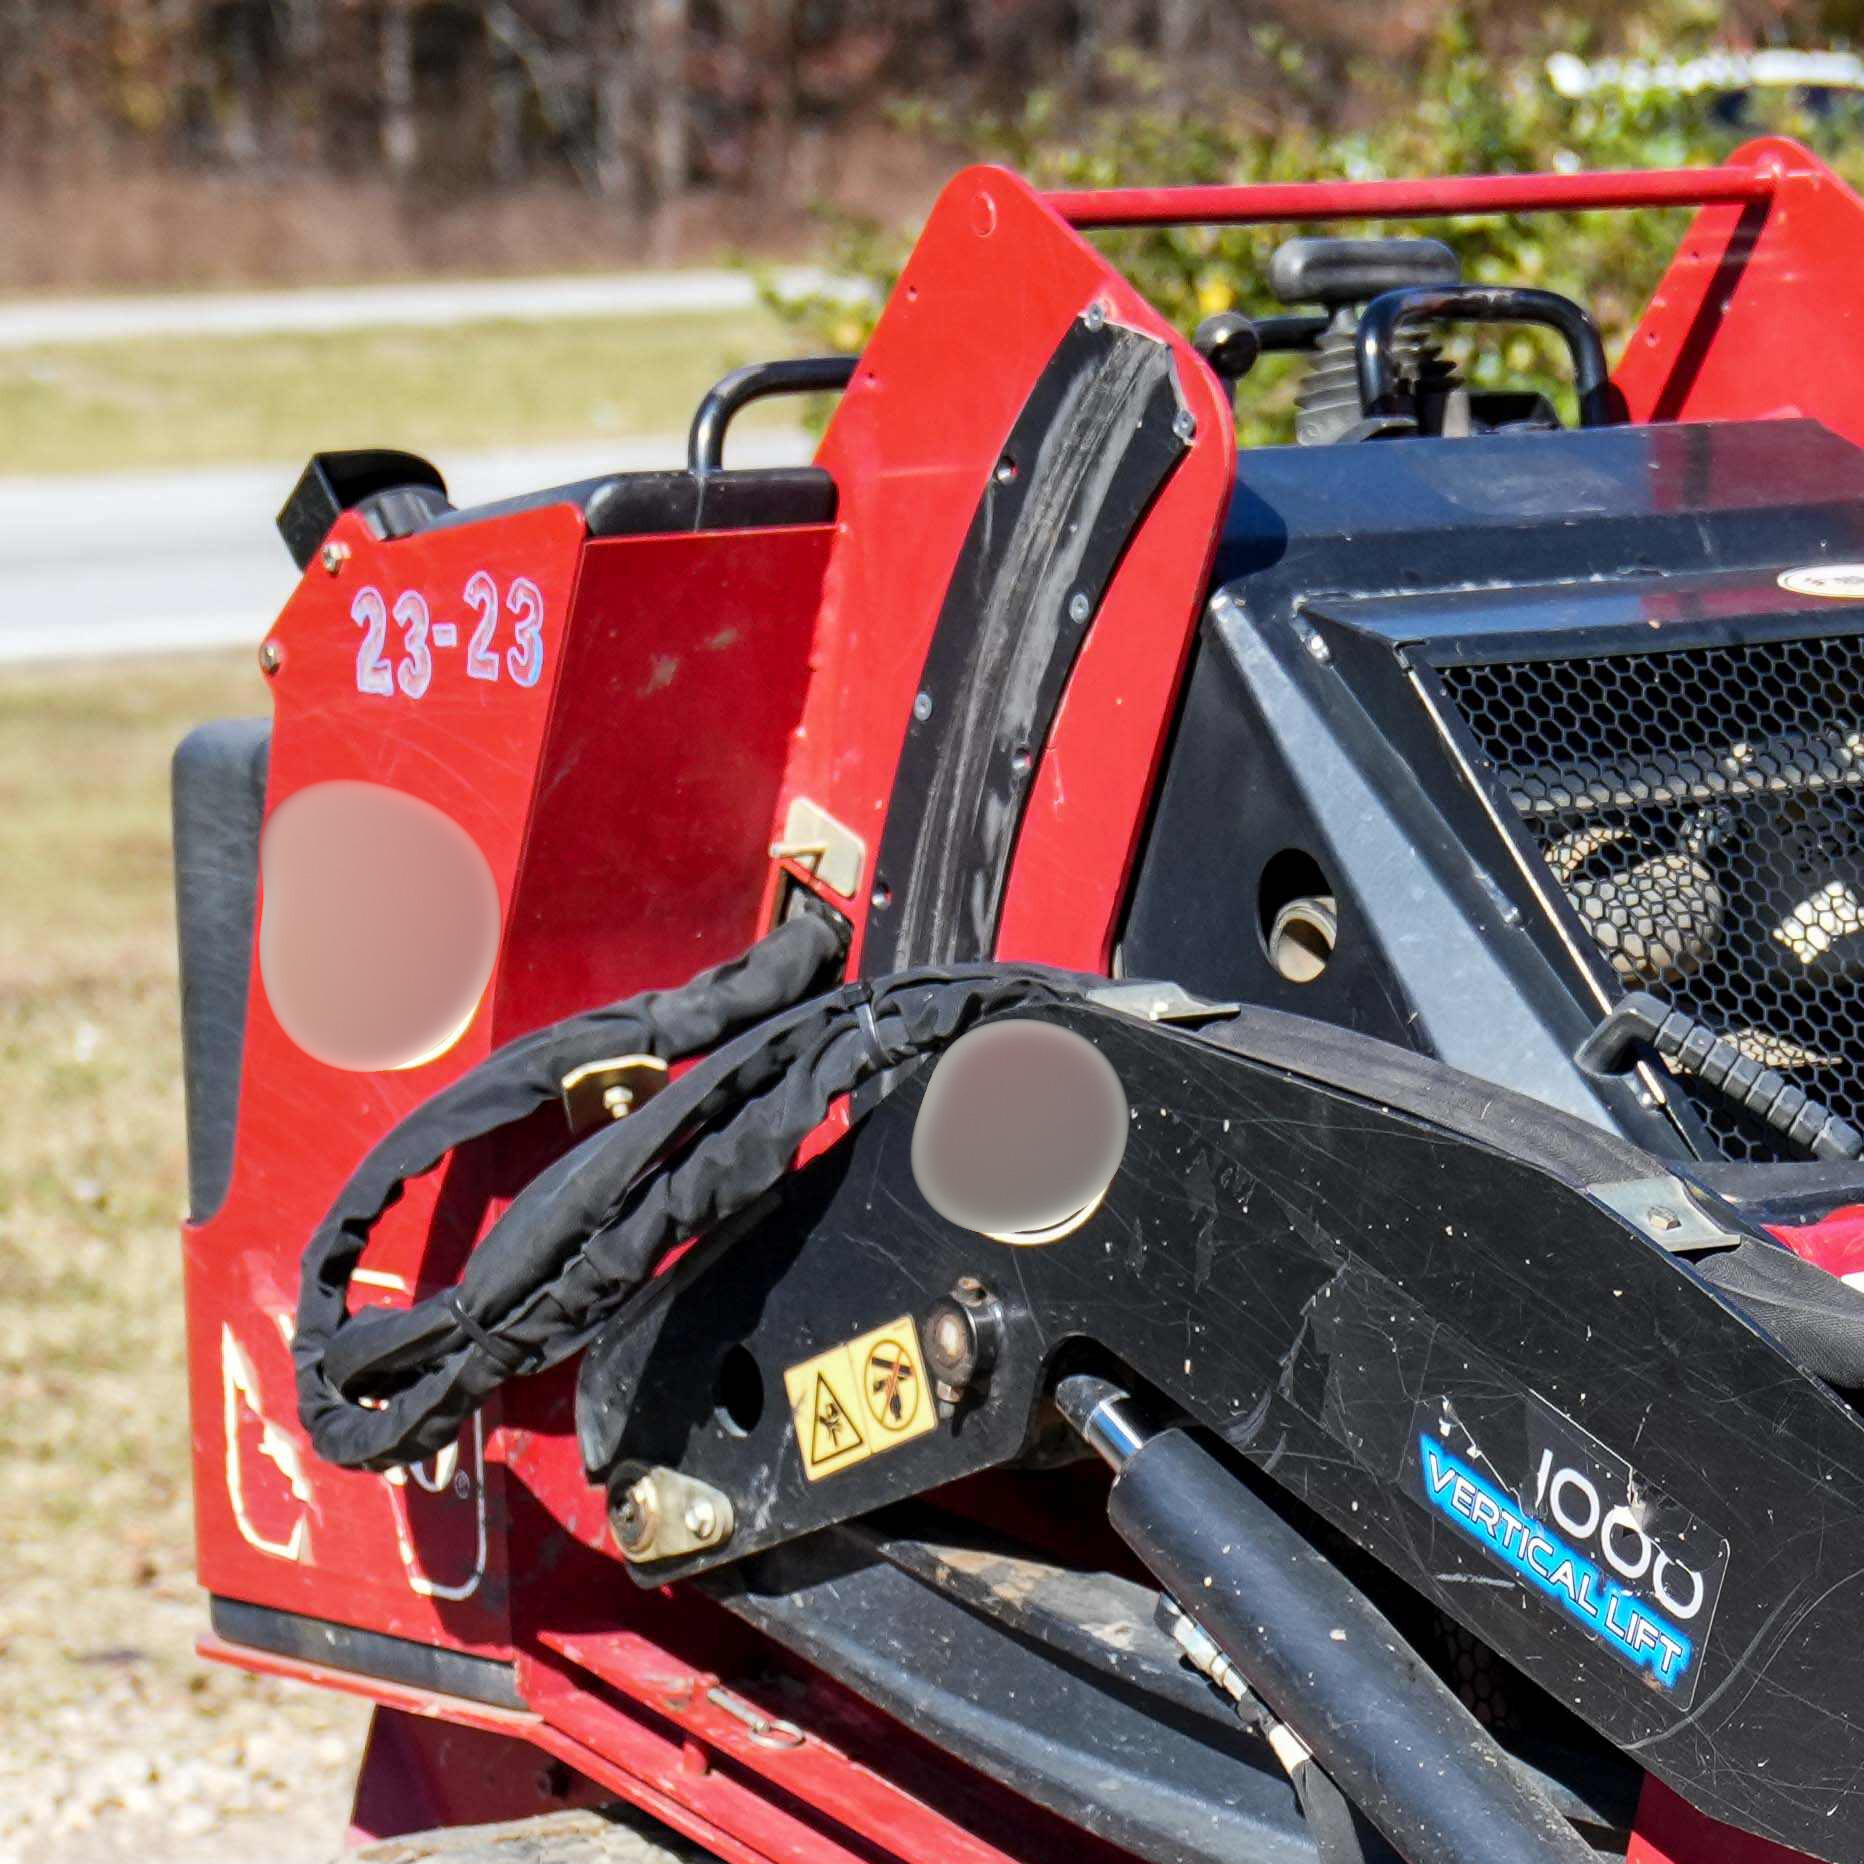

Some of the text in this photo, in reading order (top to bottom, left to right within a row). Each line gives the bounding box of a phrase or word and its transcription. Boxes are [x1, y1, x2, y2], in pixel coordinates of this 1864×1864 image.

[351, 570, 544, 699] 23-23
[1428, 1450, 1683, 1674] VERTICAL LIFT
[1535, 1448, 1704, 1619] 1000
